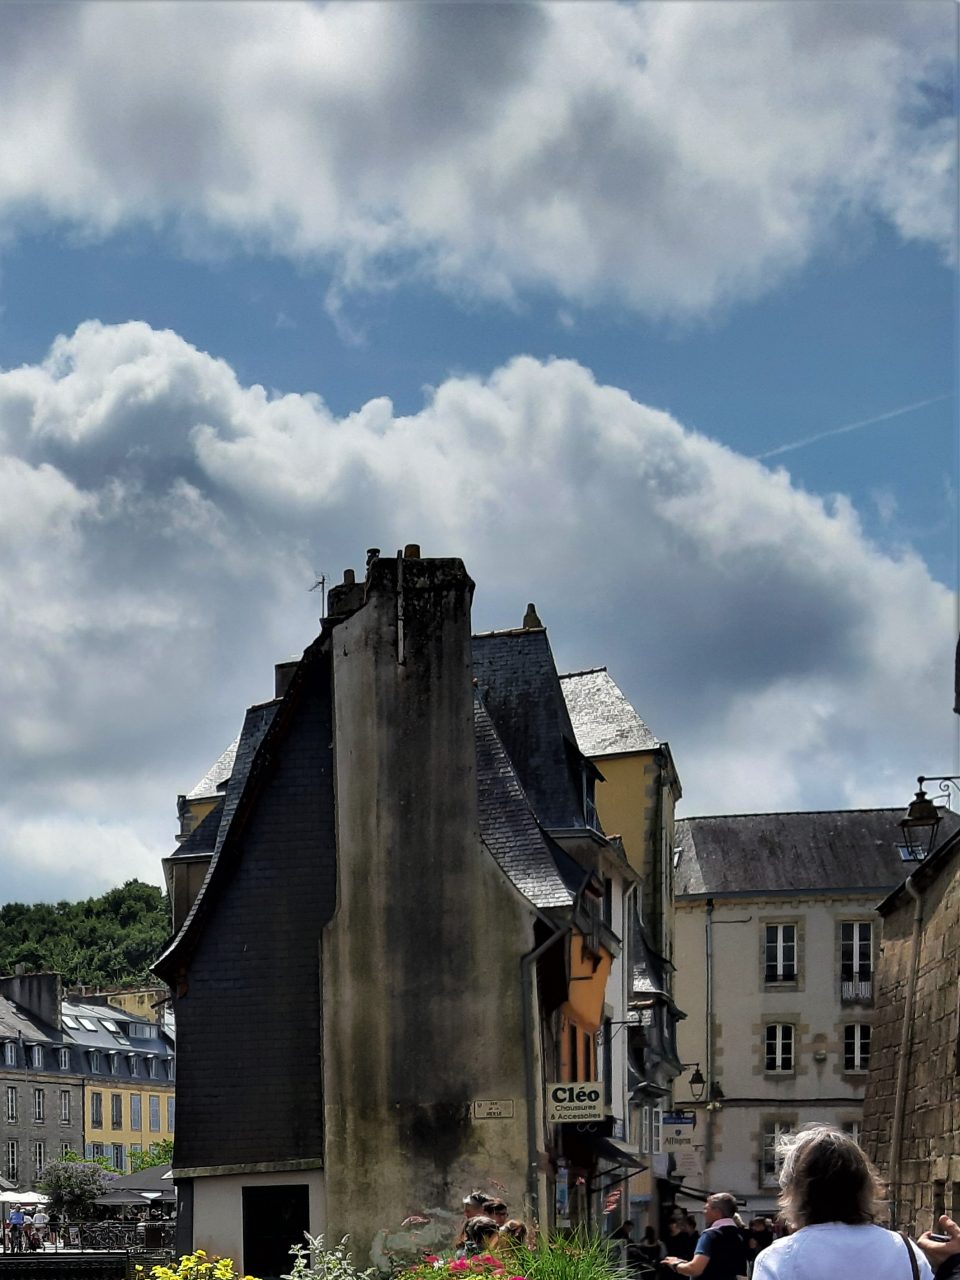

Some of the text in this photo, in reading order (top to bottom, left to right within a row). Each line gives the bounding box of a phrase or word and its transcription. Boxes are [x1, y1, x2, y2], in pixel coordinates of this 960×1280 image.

[551, 1086, 600, 1103] Cléo
[554, 1104, 597, 1112] Chaussures
[557, 1112, 601, 1120] Accessoires
